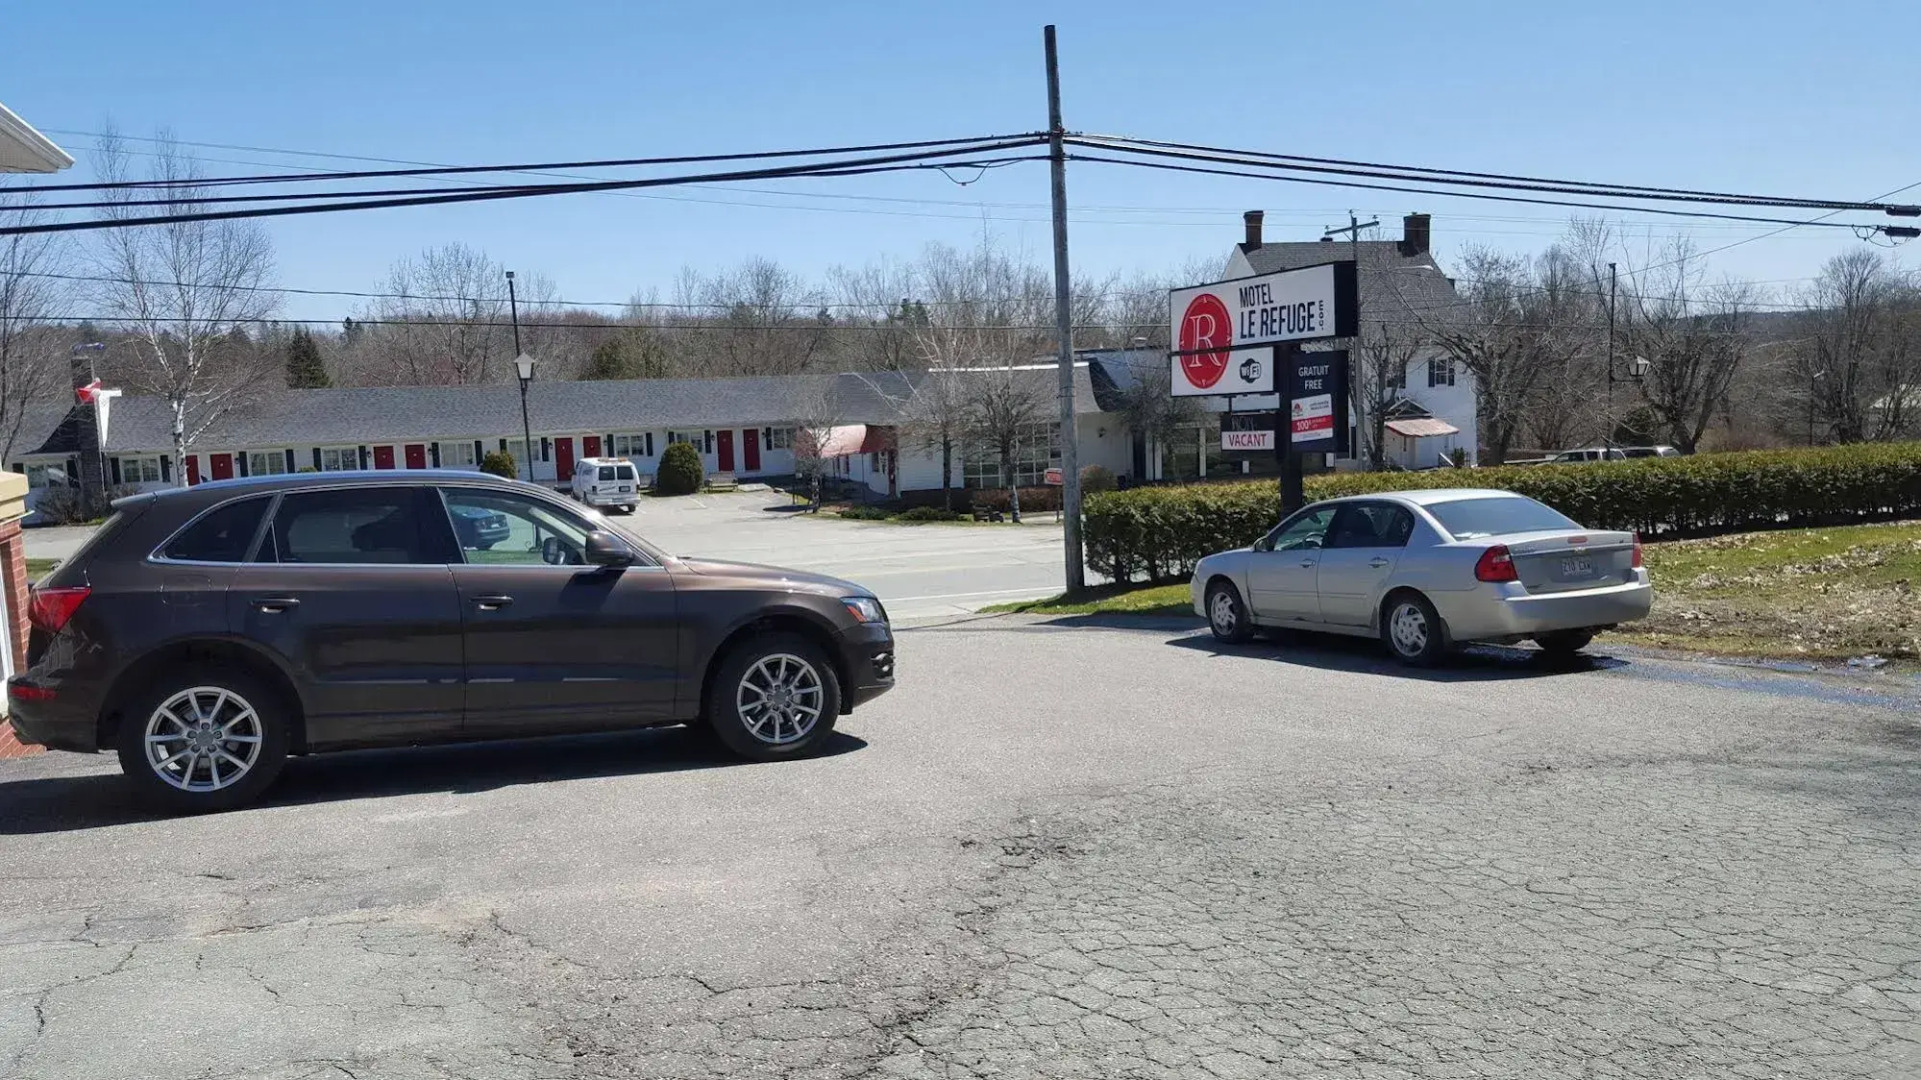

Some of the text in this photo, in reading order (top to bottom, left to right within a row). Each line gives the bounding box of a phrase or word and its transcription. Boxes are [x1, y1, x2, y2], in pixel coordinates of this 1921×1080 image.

[1239, 283, 1274, 308] MOTEL
[1240, 302, 1316, 340] LE REFUGE
[1189, 313, 1222, 368] R
[1298, 365, 1330, 378] GRATUIT
[1304, 379, 1323, 390] FREE
[1228, 433, 1267, 447] VACANT
